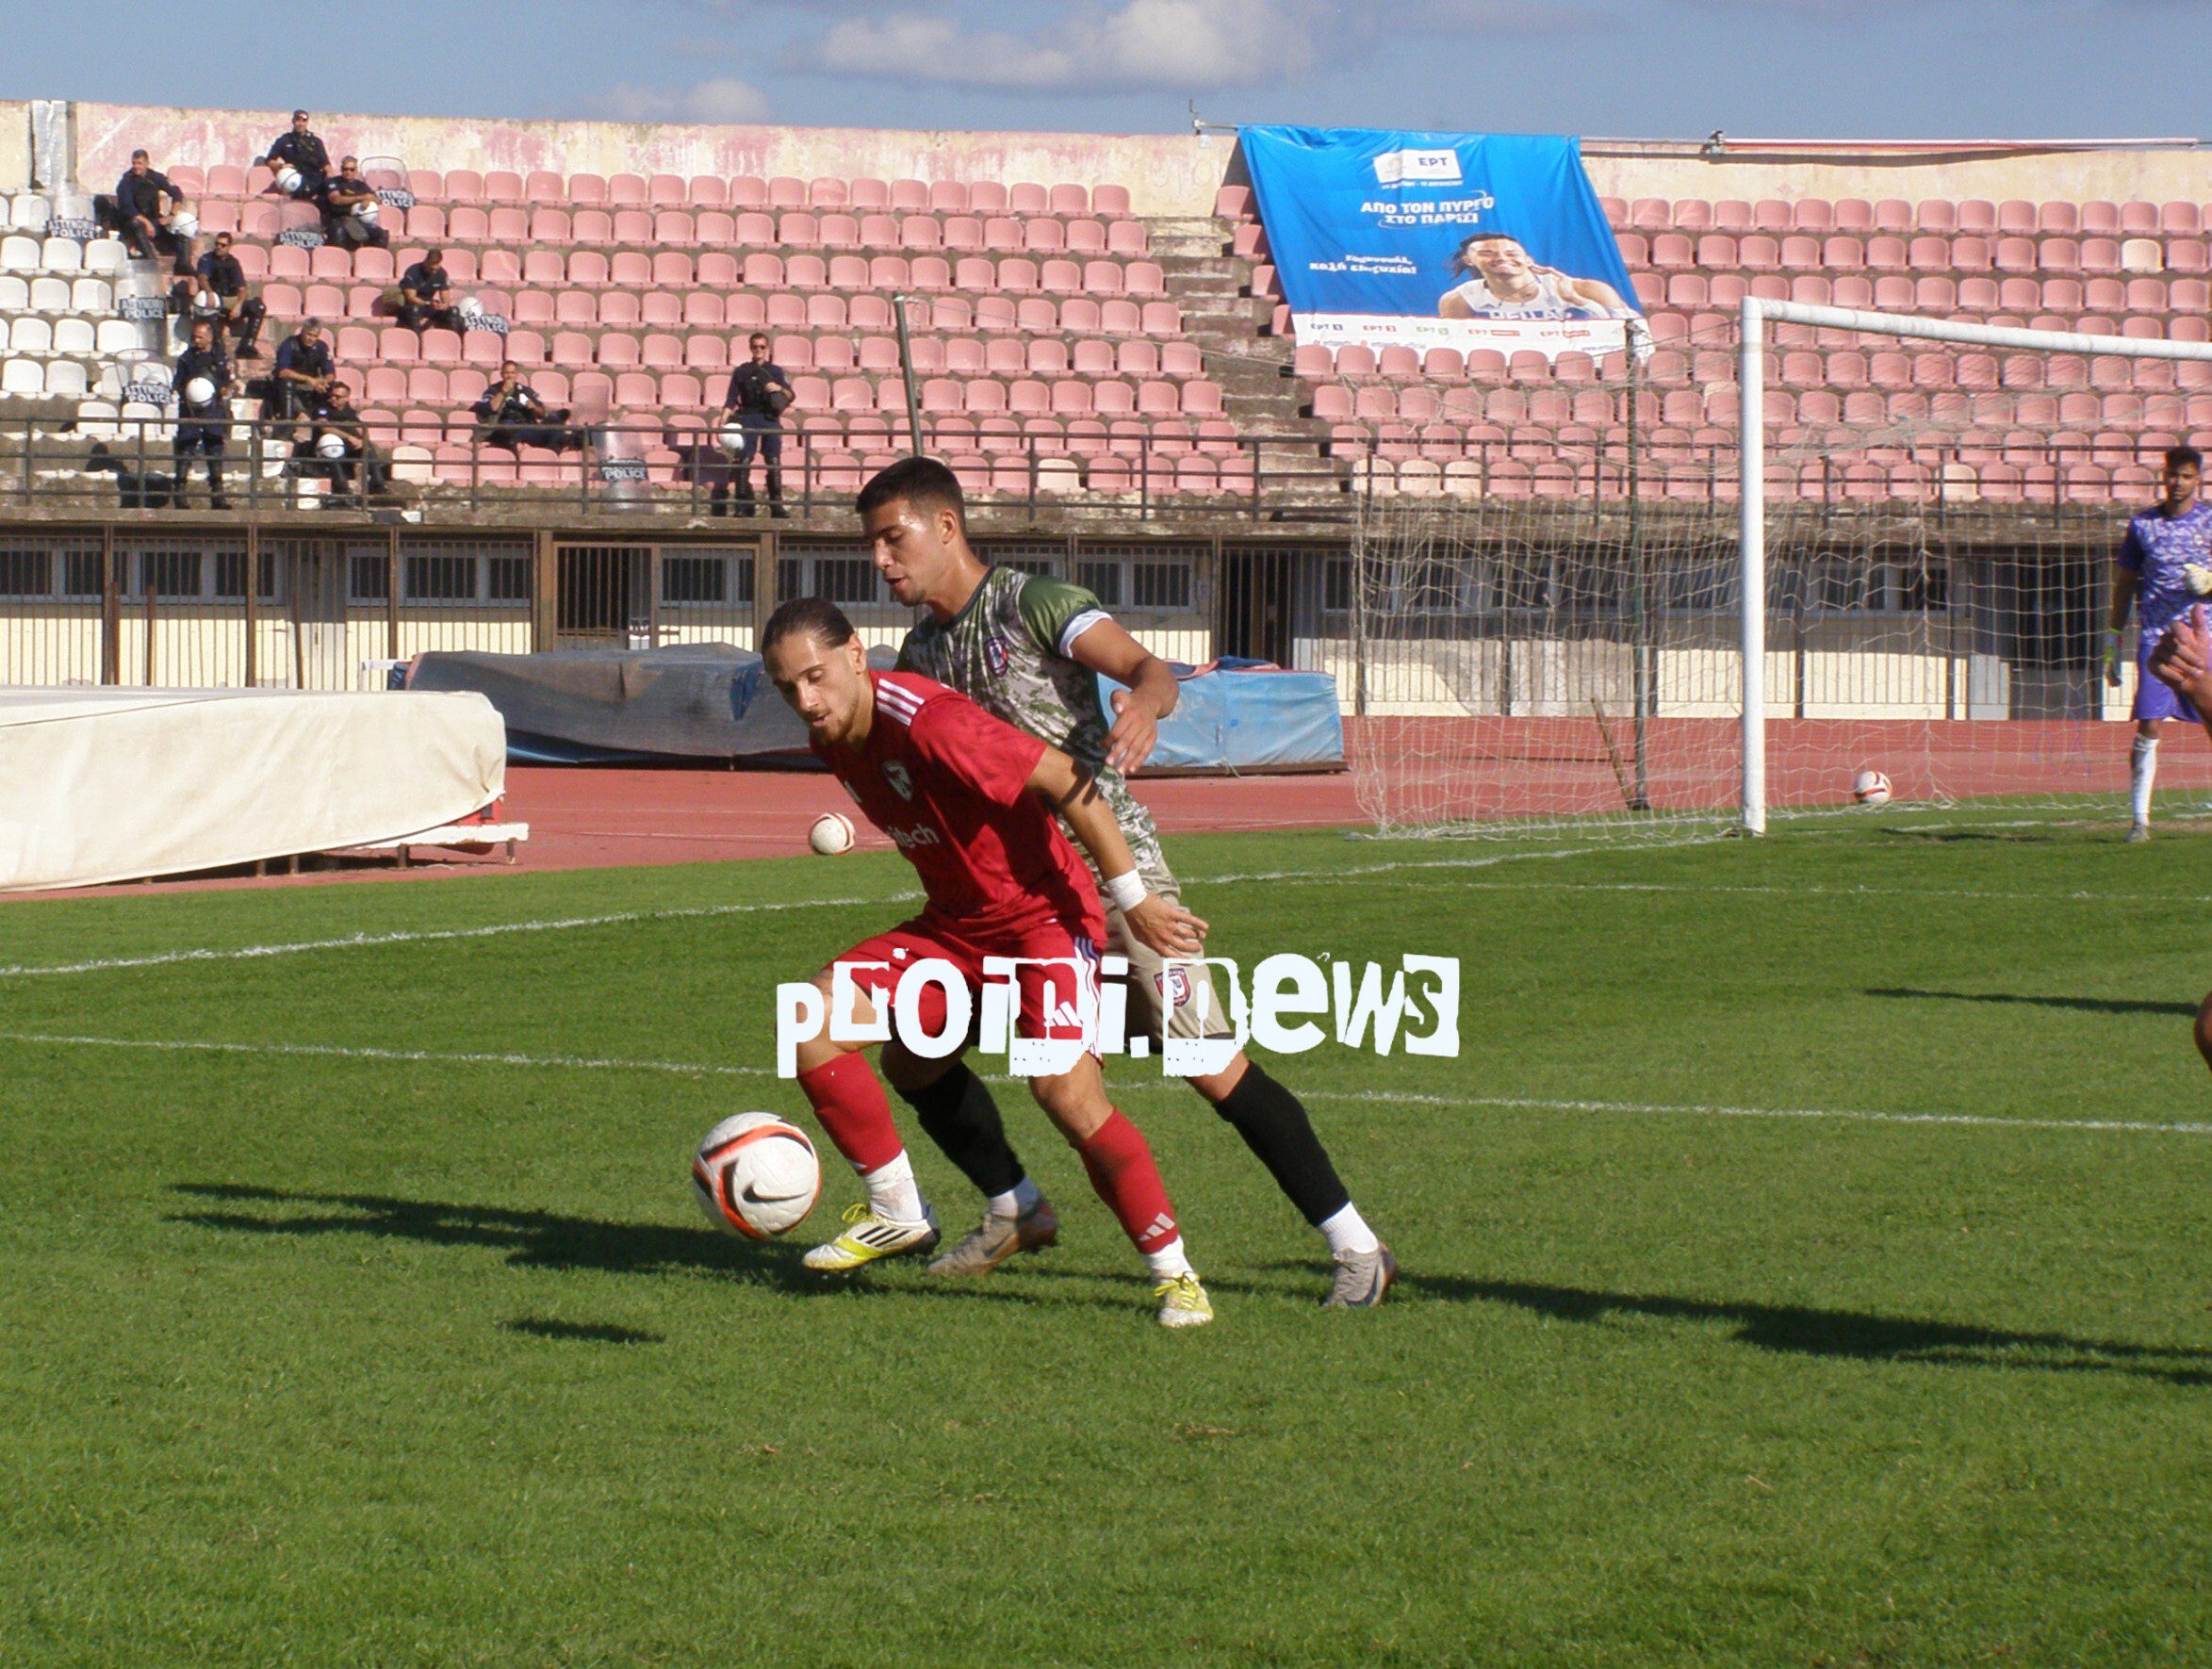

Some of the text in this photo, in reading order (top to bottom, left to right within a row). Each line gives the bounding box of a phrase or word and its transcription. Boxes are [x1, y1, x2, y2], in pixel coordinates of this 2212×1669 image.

[1417, 157, 1448, 166] ΕΡΤ
[1361, 196, 1495, 214] ΑΠΟ ΤΟΝ ΠΥΡΓΟ
[1385, 212, 1479, 224] ΣΤΟ ΠΑΡΙΣΙ
[604, 467, 647, 480] POLICE
